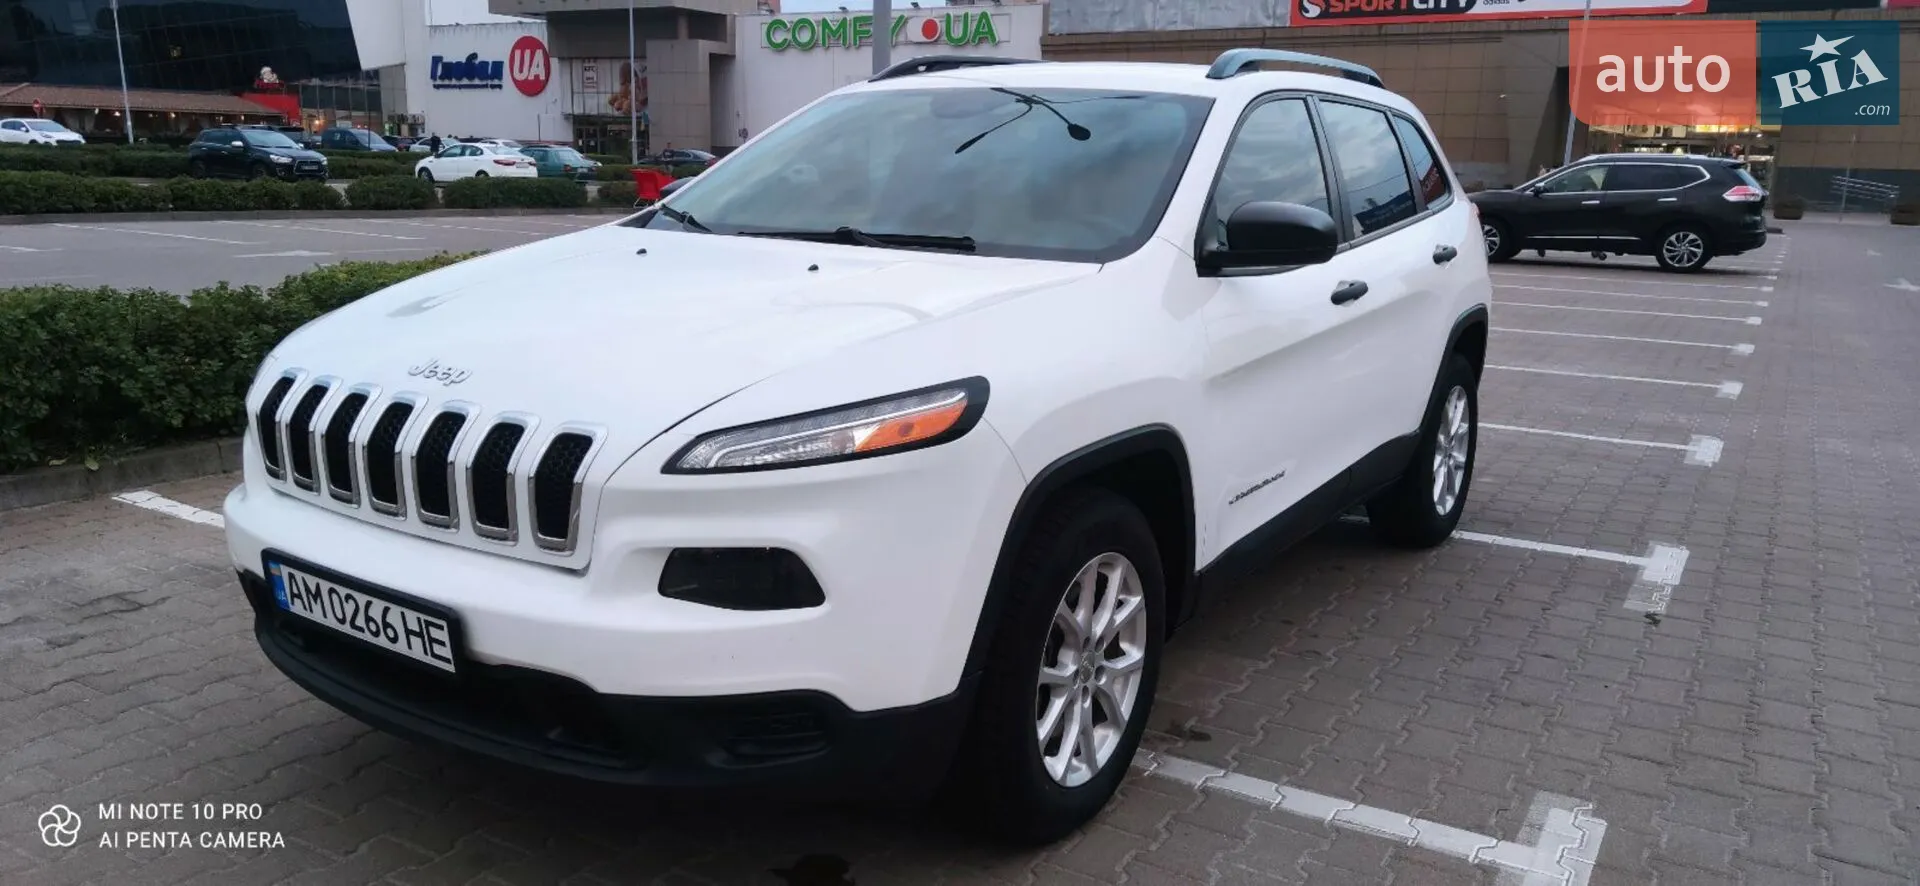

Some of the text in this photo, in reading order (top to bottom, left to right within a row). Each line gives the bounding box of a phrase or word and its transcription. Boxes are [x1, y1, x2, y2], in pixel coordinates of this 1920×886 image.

[944, 11, 1000, 46] UA
[513, 49, 546, 81] UA
[407, 358, 473, 387] Jeep
